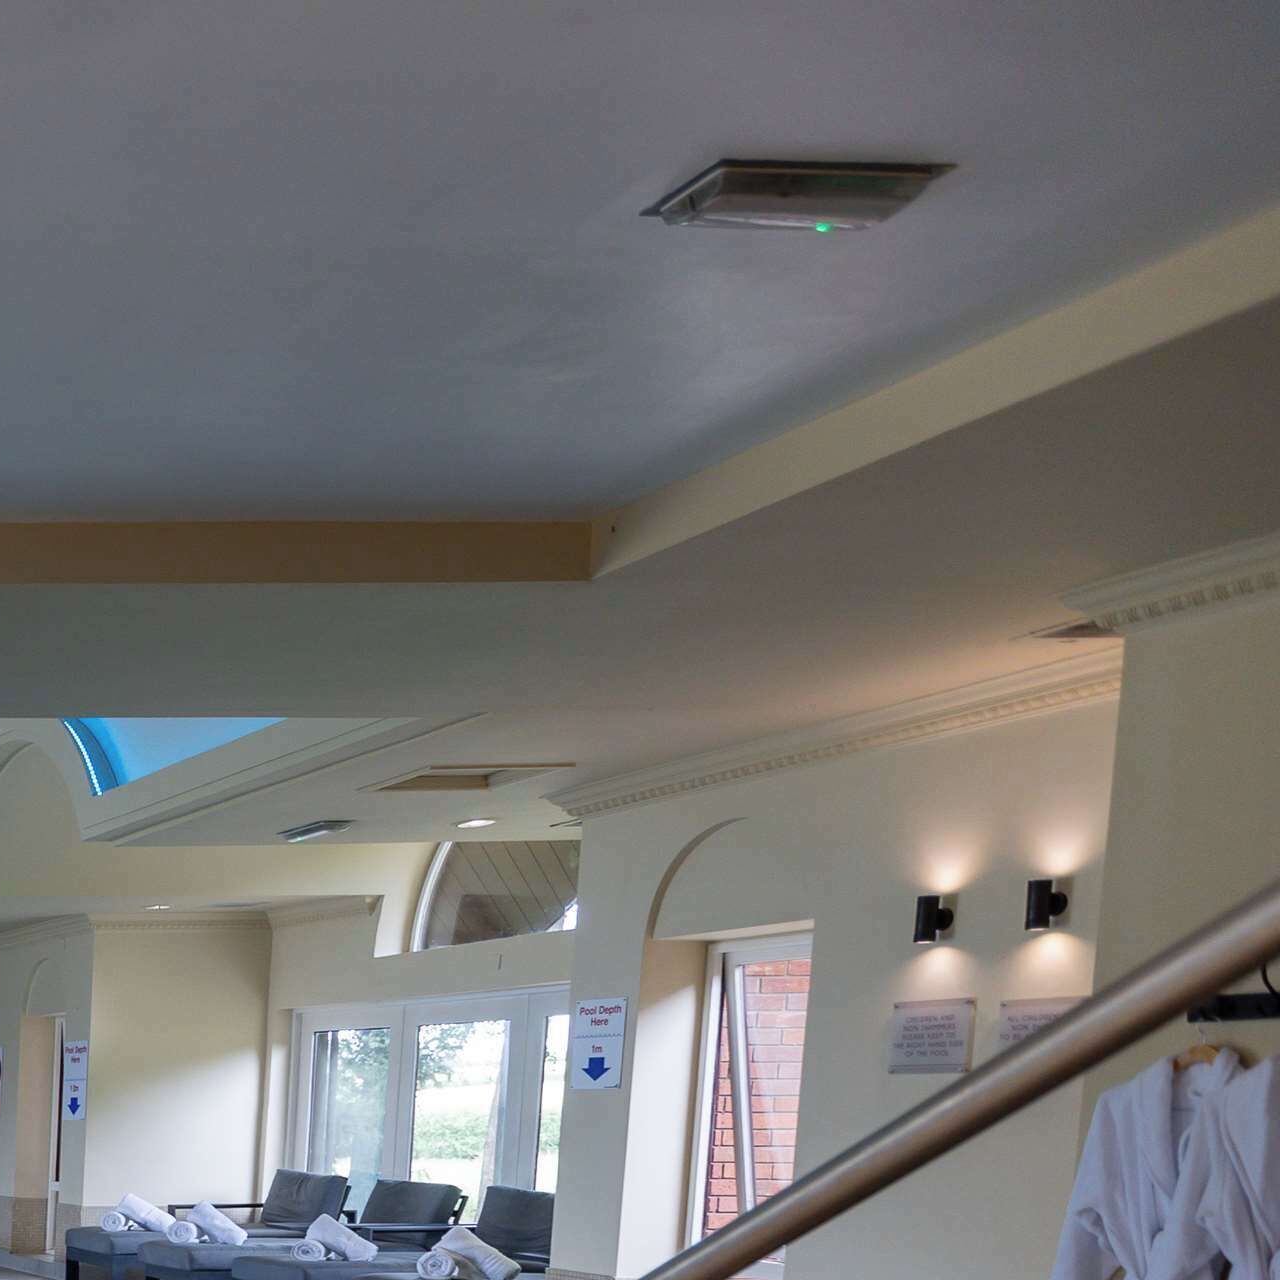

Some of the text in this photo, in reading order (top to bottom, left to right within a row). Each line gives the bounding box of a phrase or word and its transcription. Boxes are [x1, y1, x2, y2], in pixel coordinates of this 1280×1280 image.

[579, 1005, 622, 1016] Pool Depth
[590, 1018, 608, 1026] Here
[75, 1046, 87, 1054] Depth
[591, 1044, 602, 1053] 1m
